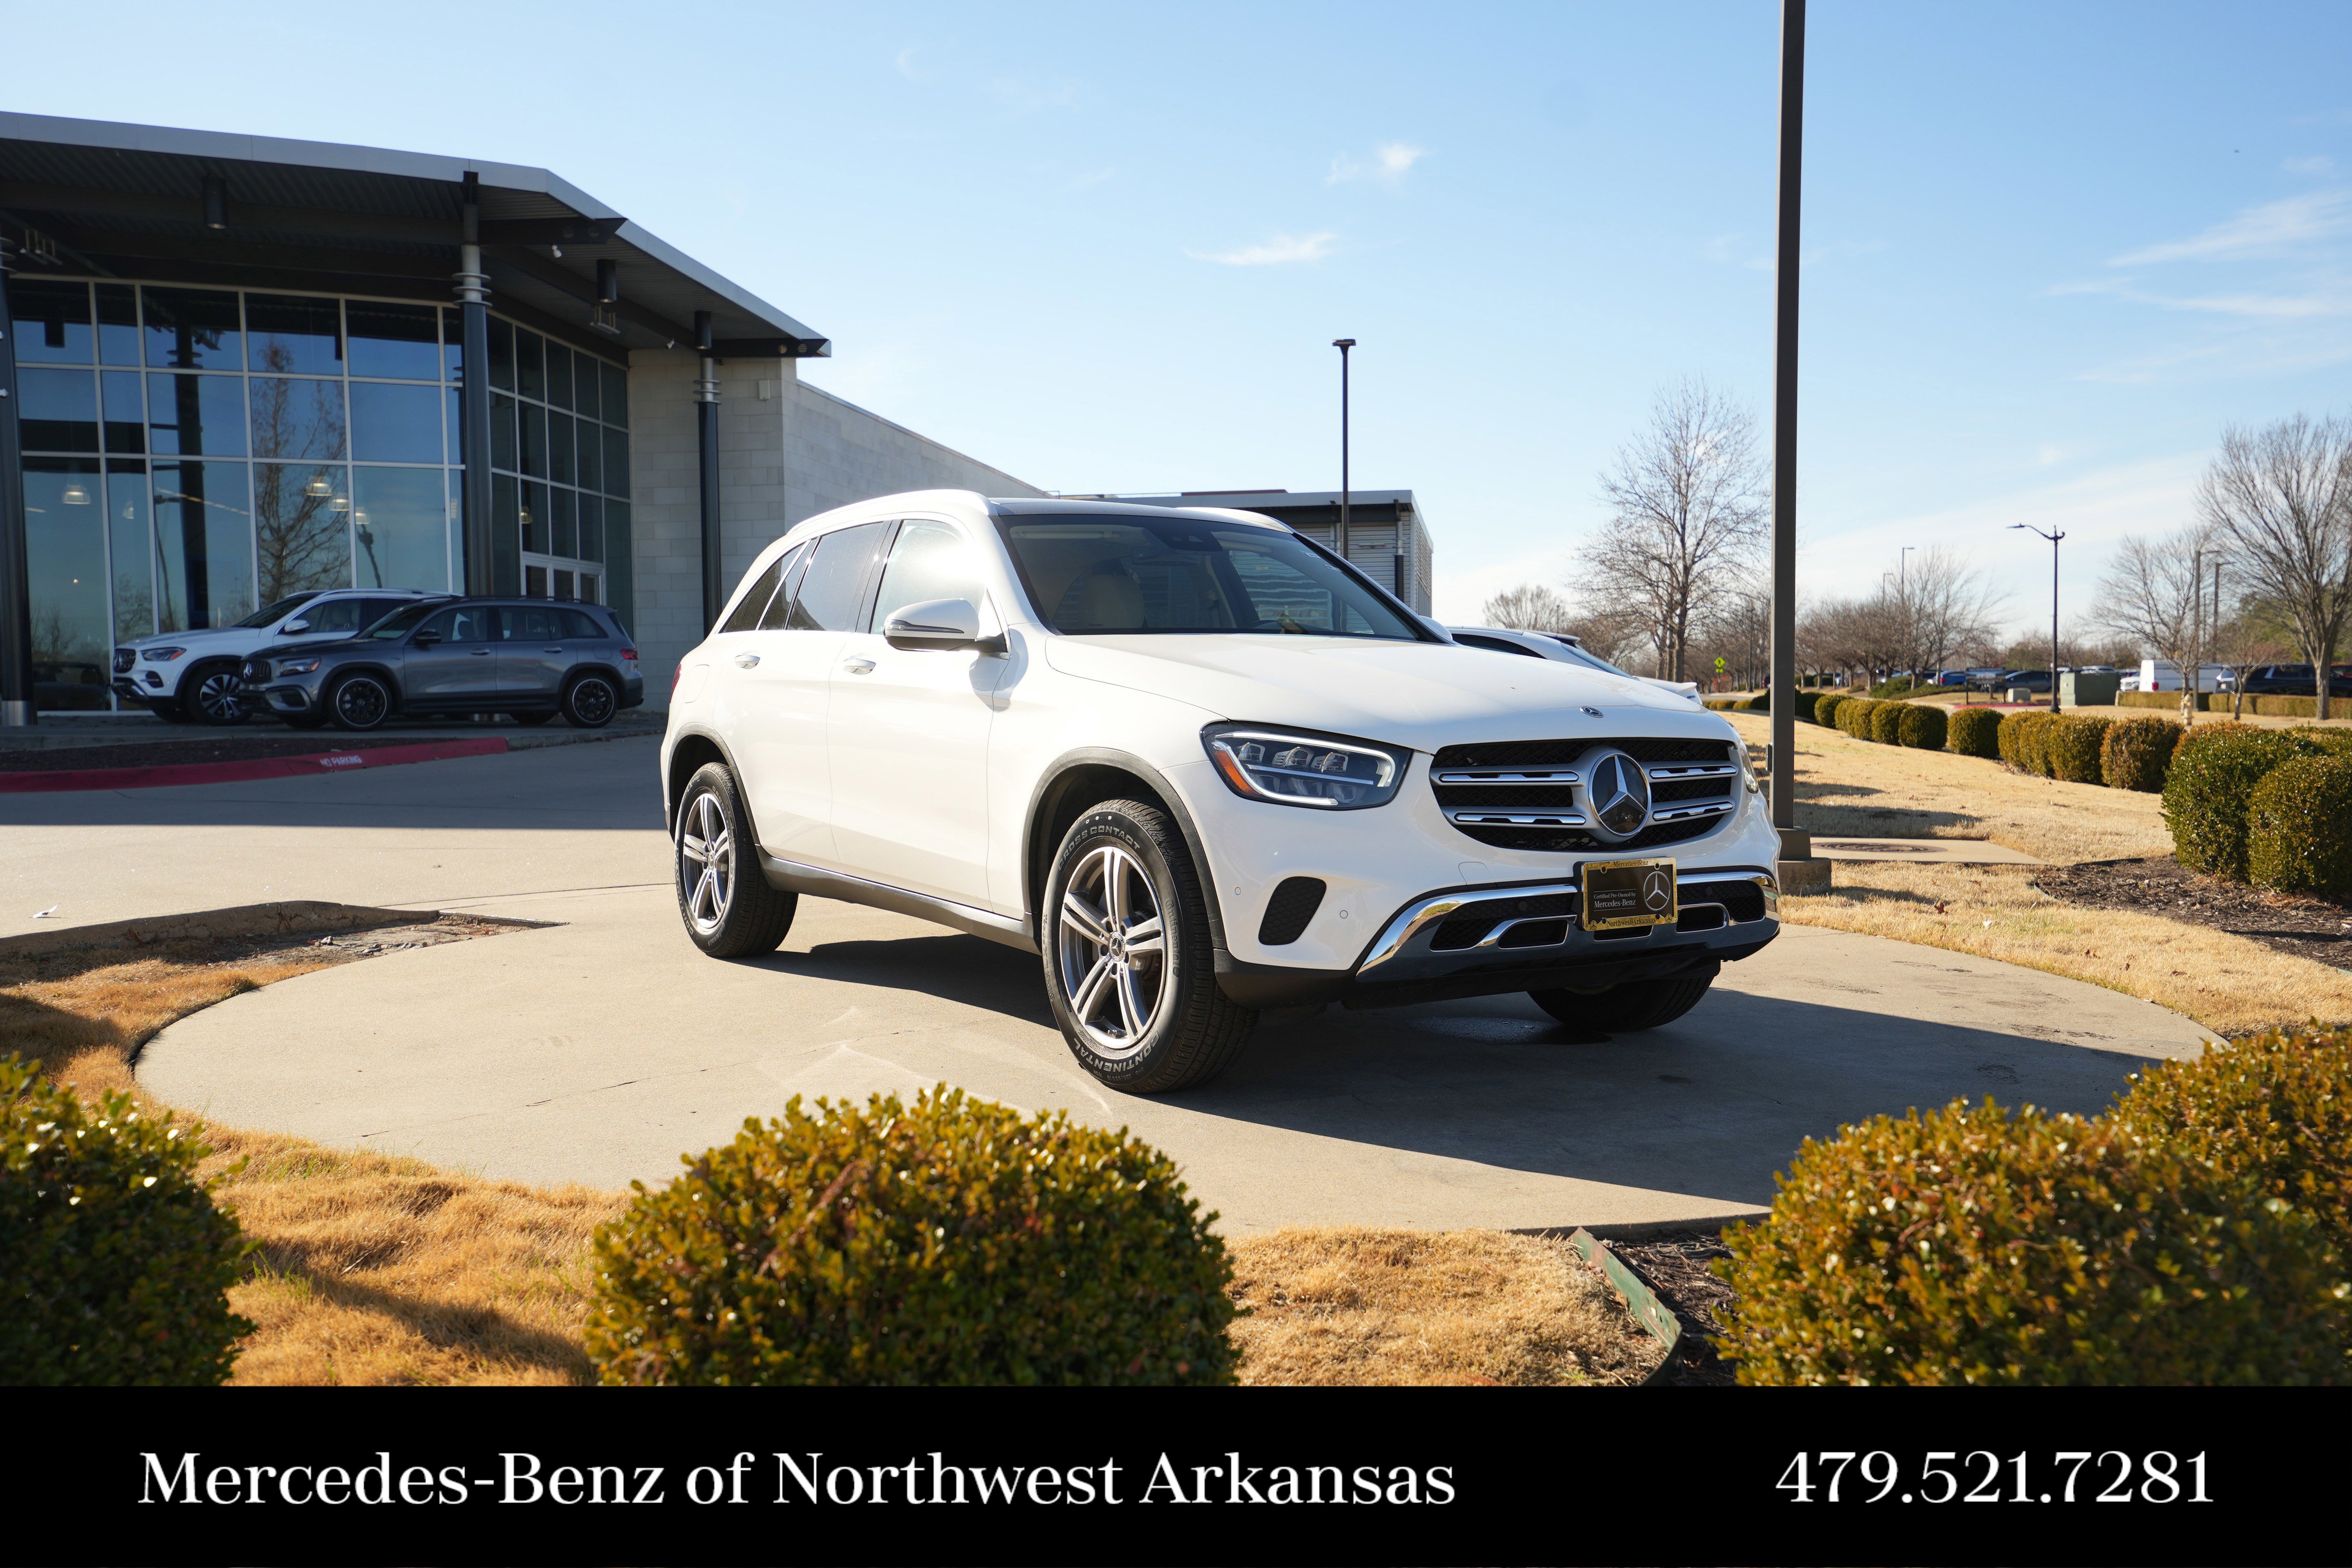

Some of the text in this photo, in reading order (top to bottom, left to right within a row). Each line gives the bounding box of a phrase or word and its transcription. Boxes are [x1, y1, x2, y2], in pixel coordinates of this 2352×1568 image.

[320, 755, 362, 766] NO PARKING
[1058, 825, 1140, 871] CROSS CONTACT
[1594, 899, 1636, 908] Mercedes-Benz
[1607, 919, 1633, 927] Northwest
[1074, 1031, 1160, 1072] CONTINENTAL
